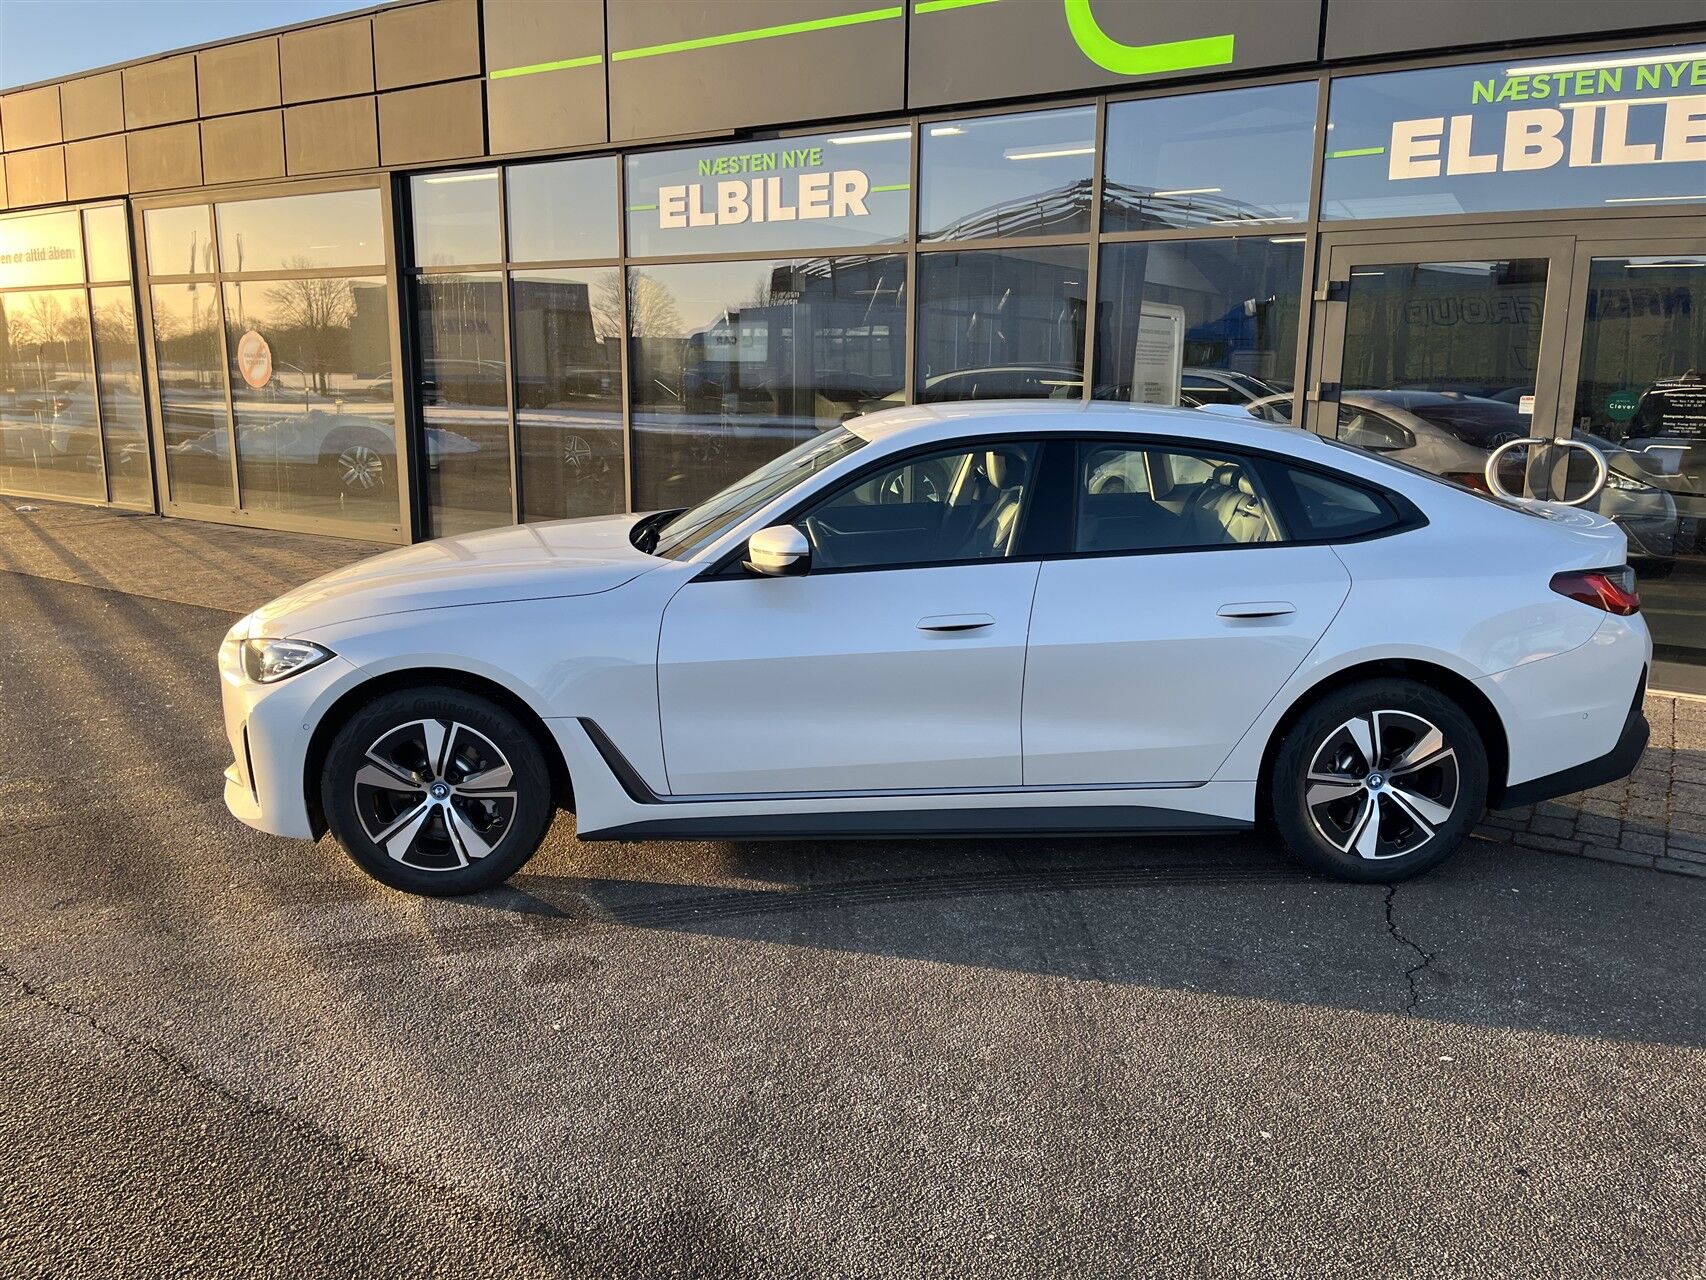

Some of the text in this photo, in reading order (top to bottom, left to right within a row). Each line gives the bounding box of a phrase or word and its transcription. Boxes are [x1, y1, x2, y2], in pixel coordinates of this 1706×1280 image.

[1471, 60, 1706, 105] NÆSTEN NYE
[1388, 98, 1706, 180] ELBILE
[698, 148, 823, 177] NÆSTEN NYE
[659, 170, 870, 228] ELBILER
[26, 248, 46, 262] altid
